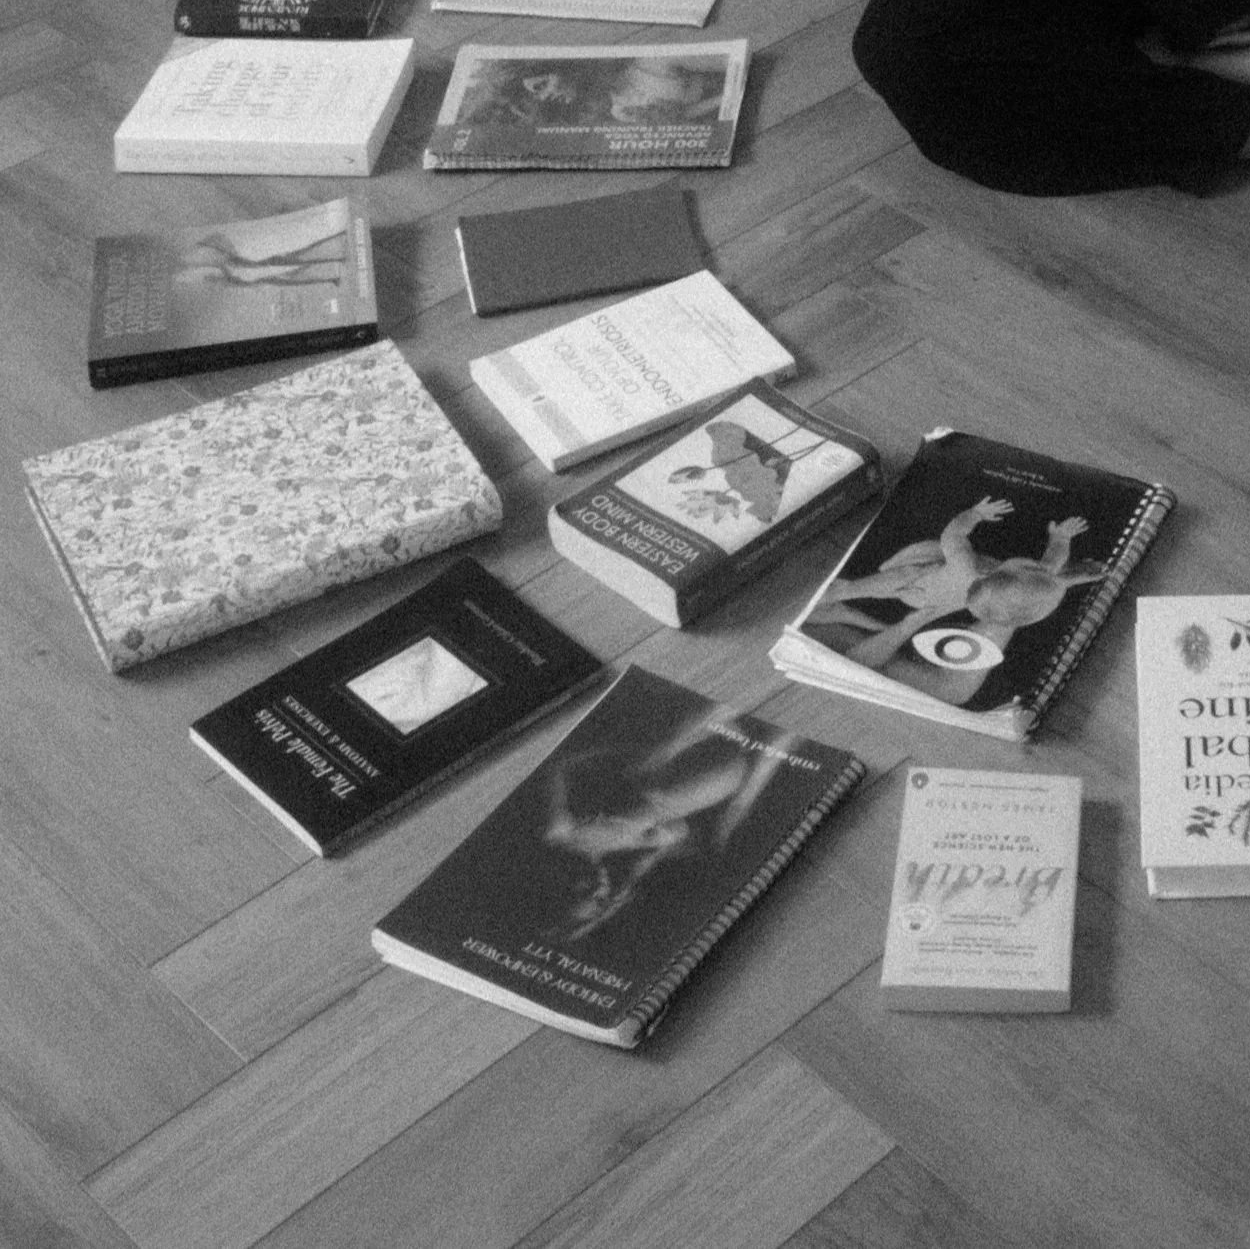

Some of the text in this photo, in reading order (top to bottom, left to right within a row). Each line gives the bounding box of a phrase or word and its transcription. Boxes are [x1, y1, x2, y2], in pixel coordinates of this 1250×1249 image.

[607, 139, 708, 148] 300 HOUR
[643, 131, 711, 139] ADVANCED
[656, 124, 711, 132] TEACHER
[551, 335, 605, 393] CONTROL
[589, 310, 683, 408] ENDOMETRIOSIS
[569, 503, 620, 538] BODY
[589, 491, 635, 524] MIND
[616, 530, 686, 576] EASTERN
[632, 516, 701, 562] WESTERN
[280, 692, 332, 736] EXERCISES
[252, 706, 357, 800] The Female Pelvis
[334, 740, 380, 778] ANATOMY
[932, 841, 1039, 852] THE NEW SCIENCE
[970, 833, 998, 841] LOST
[905, 861, 1063, 917] Breath
[460, 935, 541, 978] EMPOWER
[520, 939, 632, 992] PRENATAL YTT
[547, 974, 616, 1010] EMBODY
